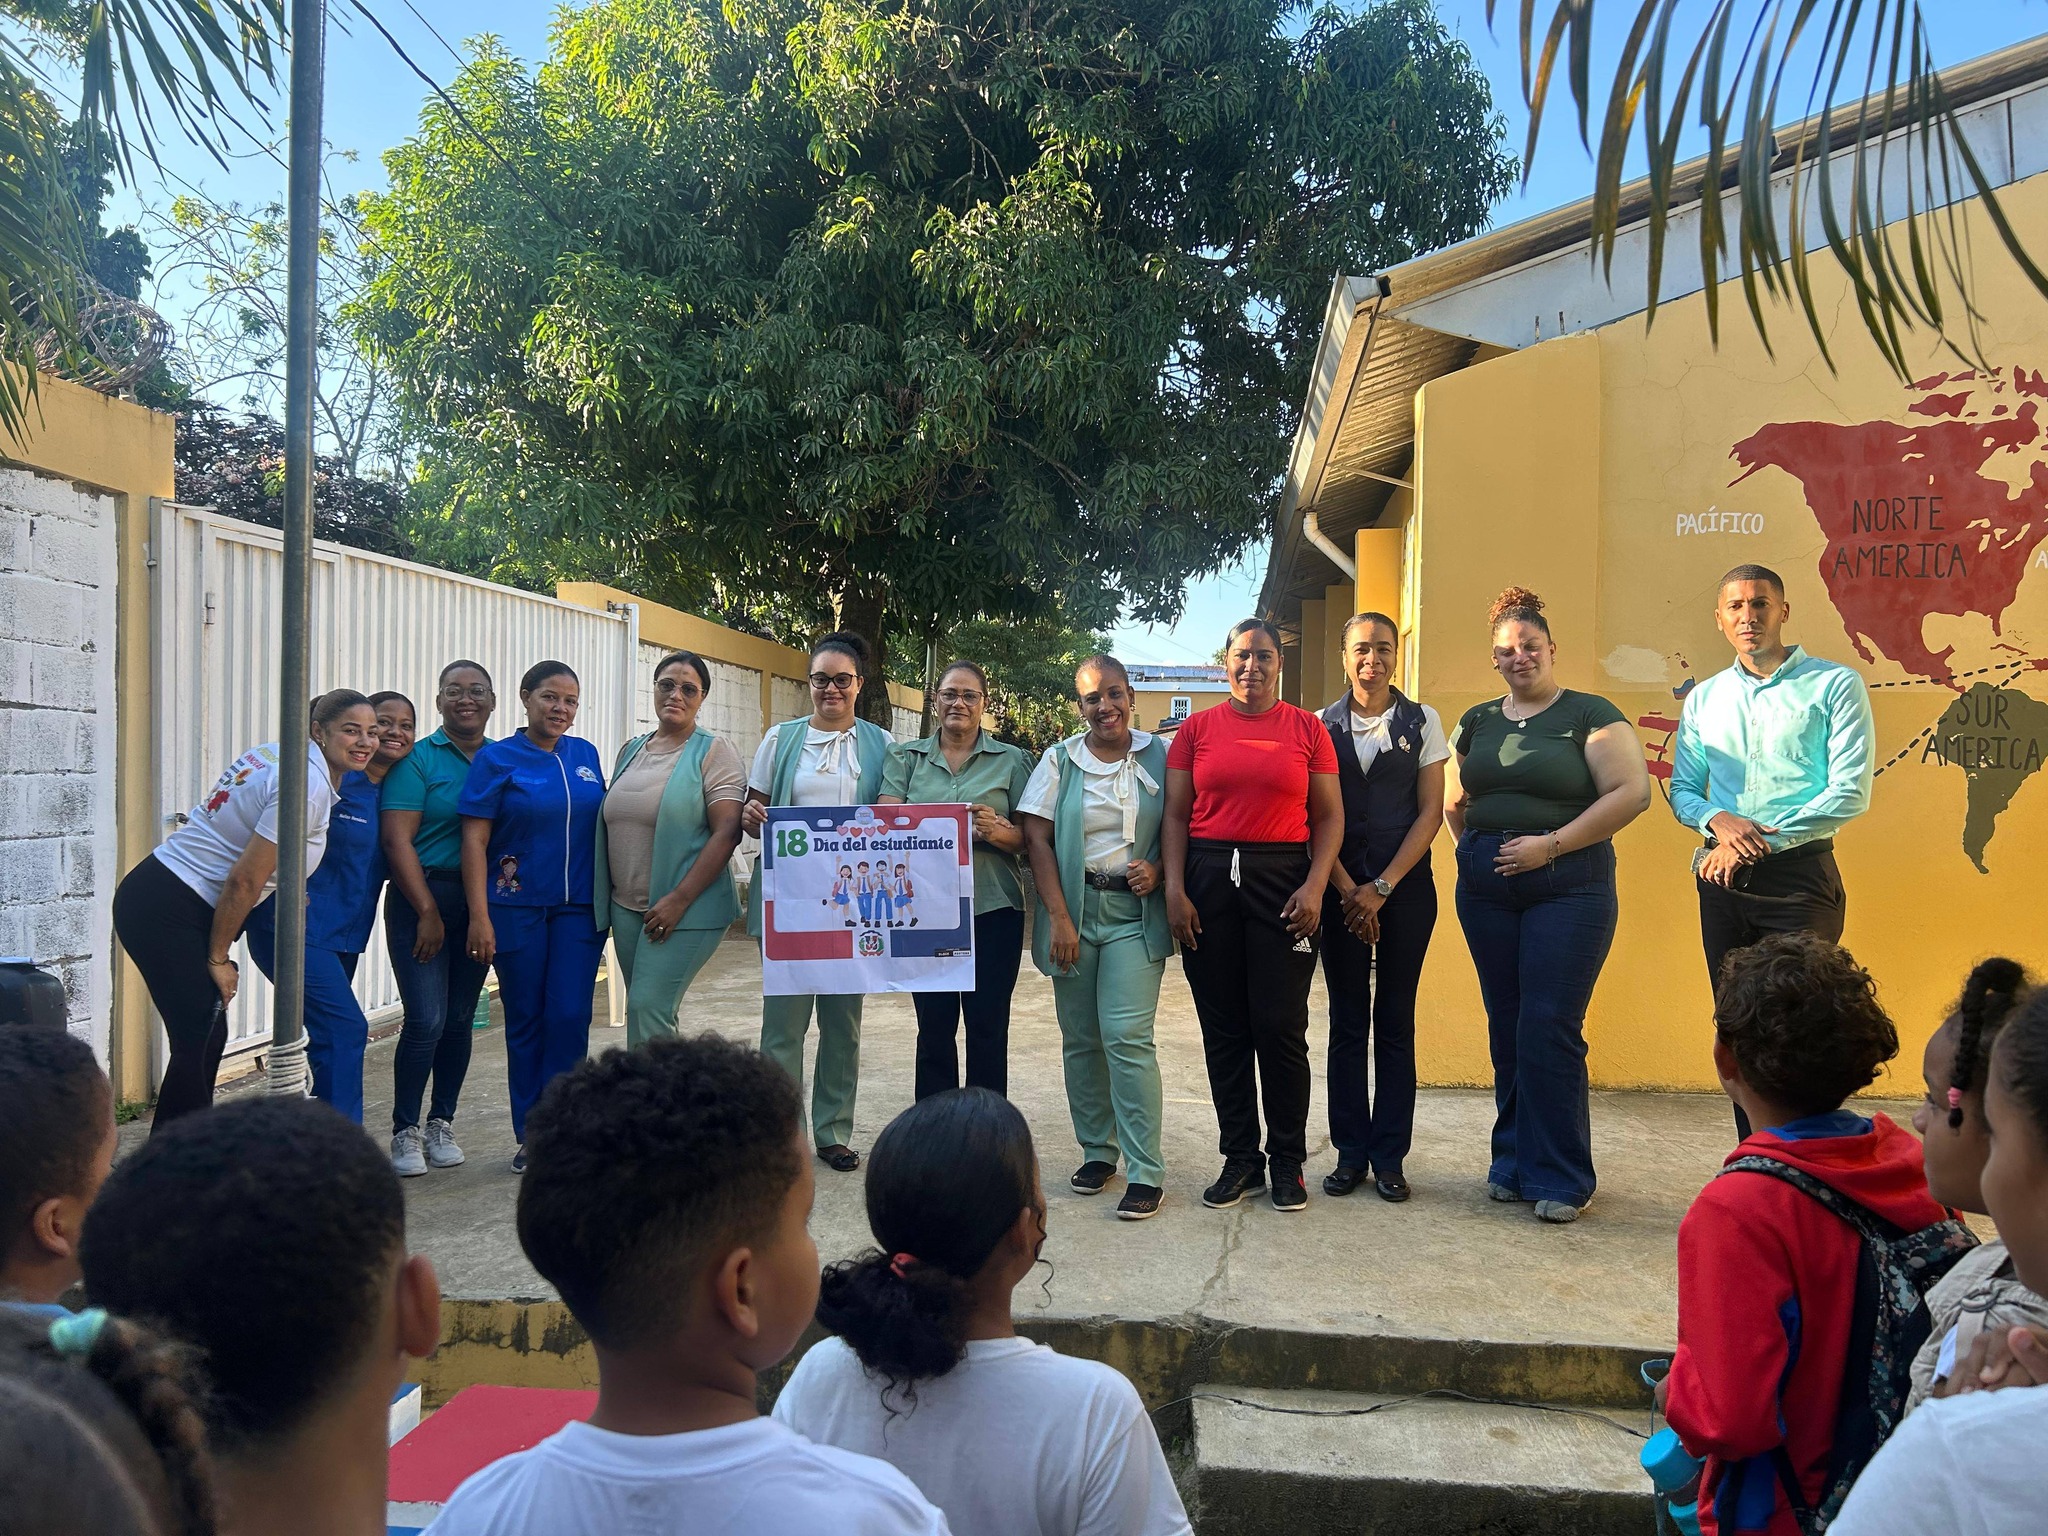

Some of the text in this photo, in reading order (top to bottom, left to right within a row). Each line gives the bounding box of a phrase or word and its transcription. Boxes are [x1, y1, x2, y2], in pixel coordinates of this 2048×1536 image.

[1675, 505, 1764, 537] PACÍFICO
[1852, 496, 1945, 534] NORTE
[1831, 543, 1967, 580] AMERICA
[1956, 692, 2011, 730] SUR
[1921, 733, 2041, 772] AMERICA
[776, 828, 809, 858] 18
[842, 836, 867, 852] del
[870, 835, 954, 851] estudiante
